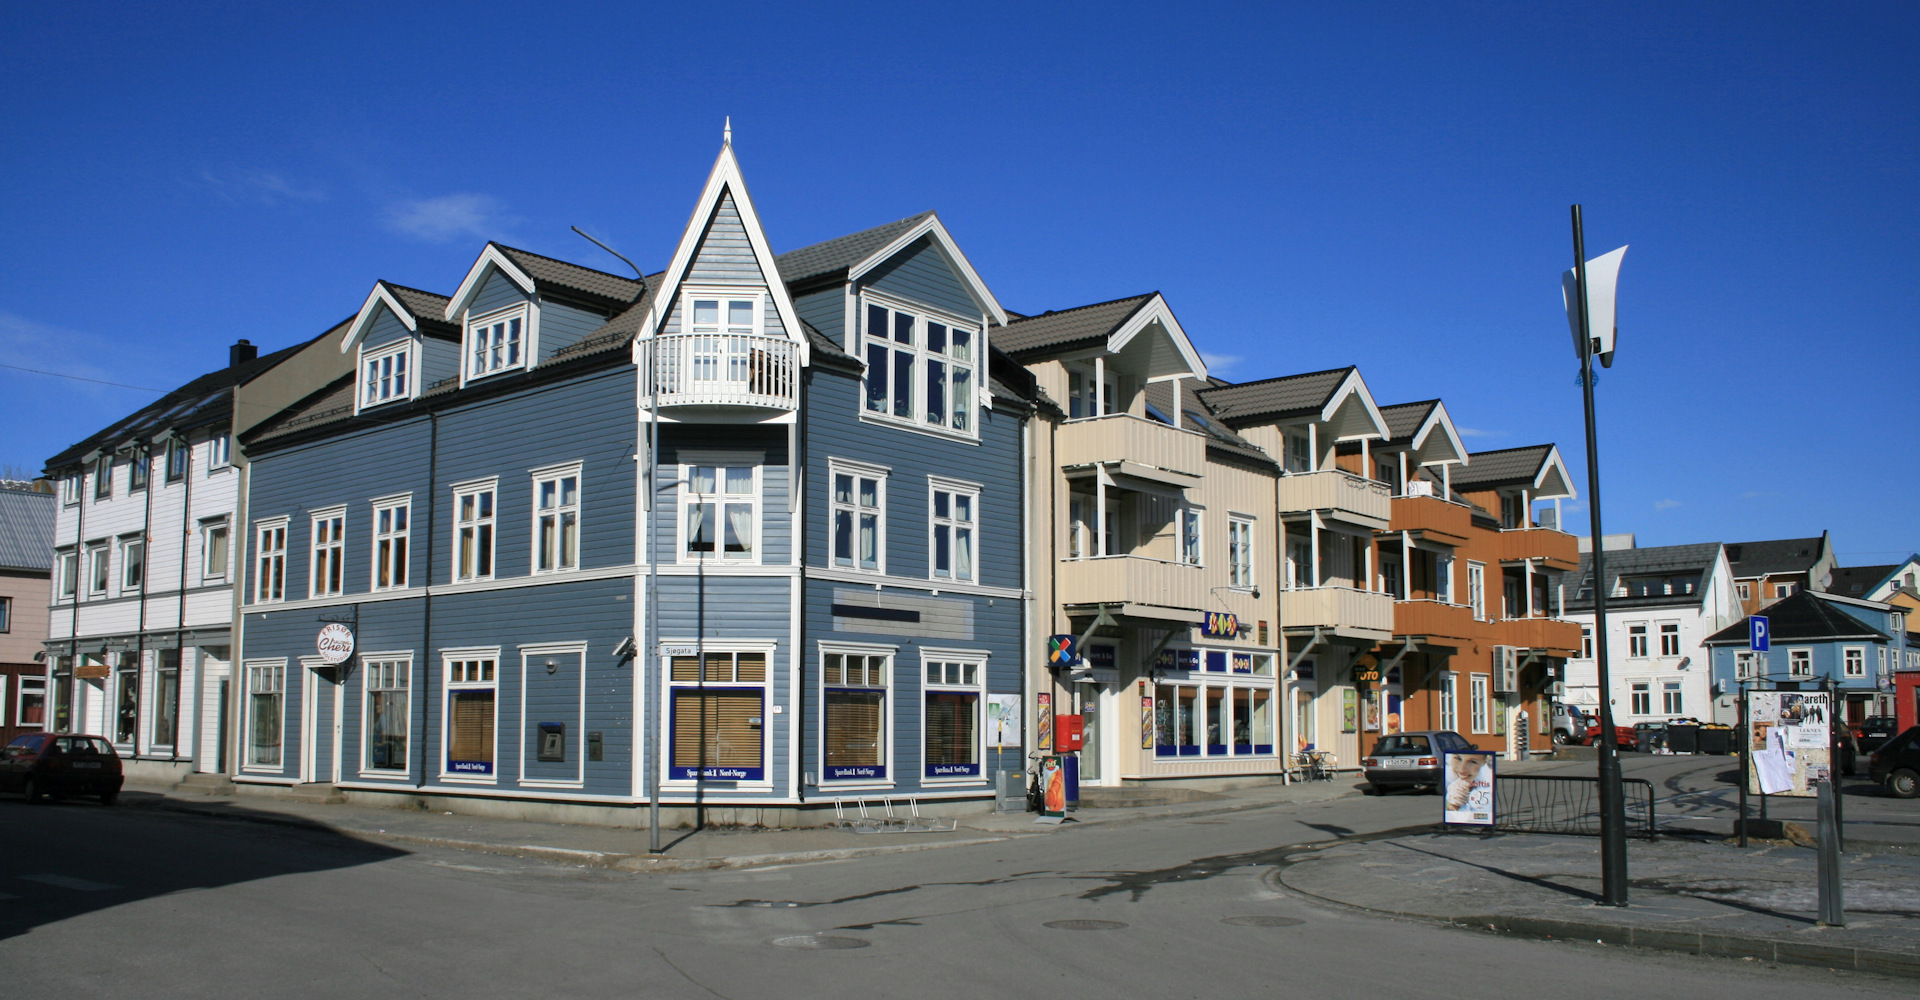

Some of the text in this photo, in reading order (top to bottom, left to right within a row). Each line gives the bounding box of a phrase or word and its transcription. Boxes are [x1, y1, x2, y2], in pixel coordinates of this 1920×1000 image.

[322, 625, 352, 637] FRISØR
[1755, 621, 1764, 647] P
[319, 637, 352, 652] Cheri
[322, 651, 350, 662] SOLSTUDIO
[665, 647, 692, 655] Sjøgata
[1356, 671, 1379, 680] TOTO
[1801, 693, 1829, 709] areth
[719, 769, 747, 779] Nord-Norge
[1468, 780, 1490, 788] Softis
[1475, 790, 1490, 805] 25
